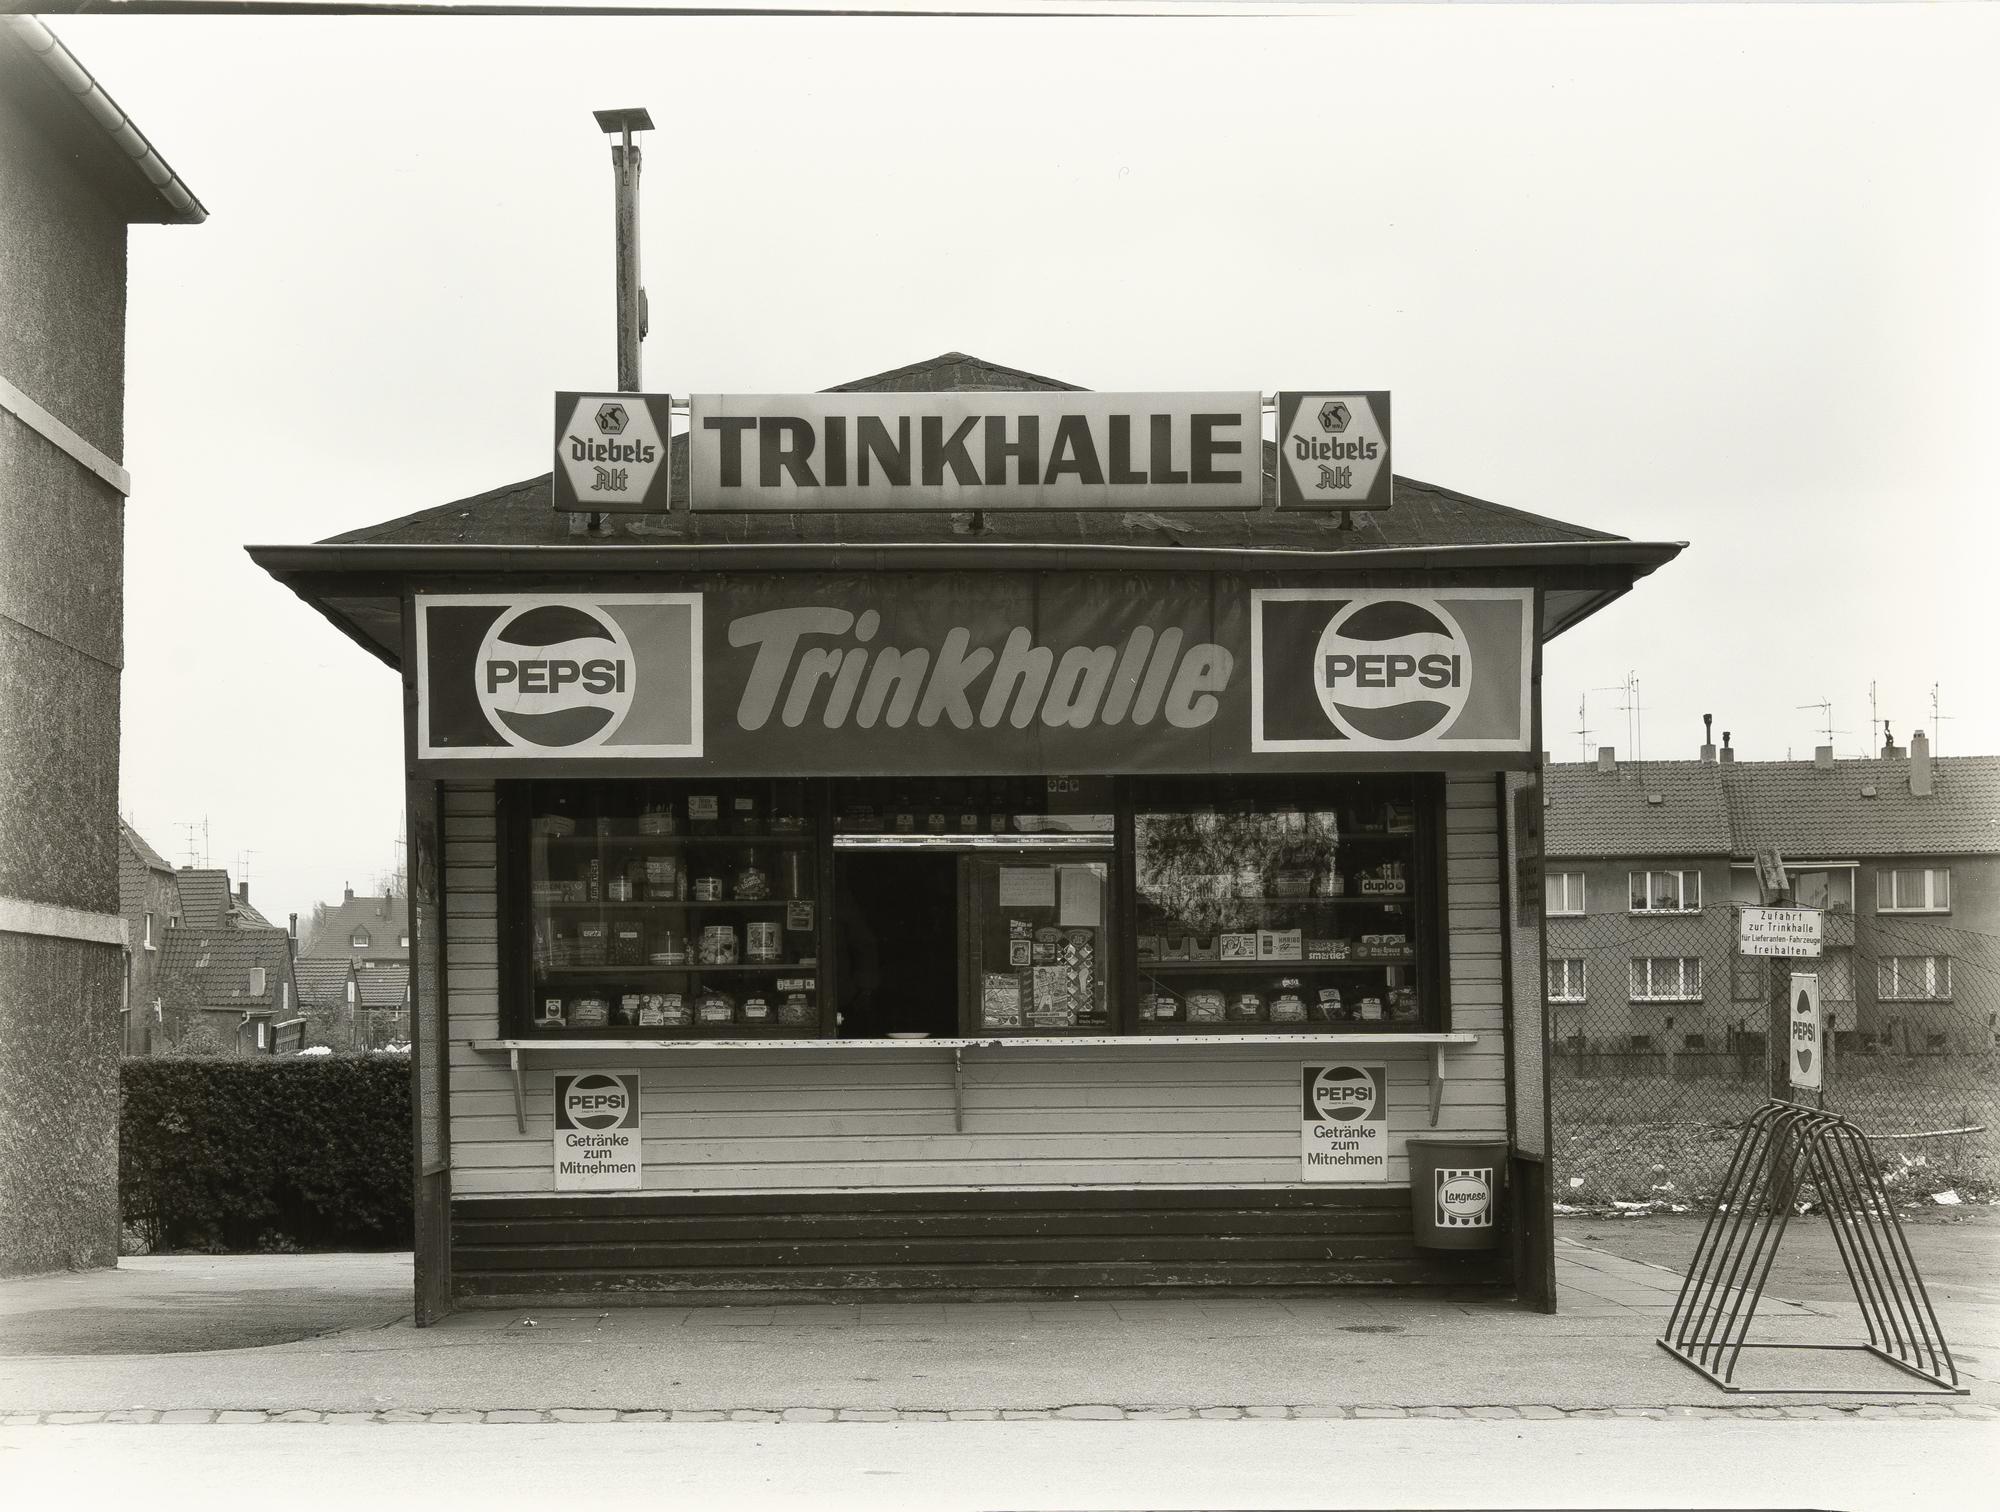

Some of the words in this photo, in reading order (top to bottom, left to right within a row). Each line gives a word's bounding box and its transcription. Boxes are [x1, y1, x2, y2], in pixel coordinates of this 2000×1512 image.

[703, 413, 1241, 487] TRINKHALLE
[590, 465, 629, 491] Alt
[1315, 463, 1353, 490] Alt
[727, 605, 1235, 730] Trinkhalle
[1325, 654, 1461, 689] PEPSI
[486, 659, 626, 695] PEPSI
[1364, 881, 1394, 893] duplo
[1760, 911, 1803, 922] Zufahrt
[1748, 923, 1764, 932] zur
[1767, 922, 1814, 933] Trinkhalle
[1741, 934, 1751, 942] für
[1308, 950, 1346, 960] smarties
[1754, 945, 1807, 955] freihalten
[1792, 1020, 1816, 1043] PEPSI
[1316, 1086, 1373, 1101] PEPSI
[568, 1094, 626, 1110] PEPSI
[1313, 1125, 1377, 1138] Getränke
[565, 1133, 629, 1147] Getränke
[1330, 1140, 1360, 1151] zum
[583, 1149, 612, 1159] zum
[1307, 1152, 1383, 1166] Mitnehmen
[560, 1161, 636, 1175] Mitnehmen
[1444, 1189, 1487, 1204] Langnese
